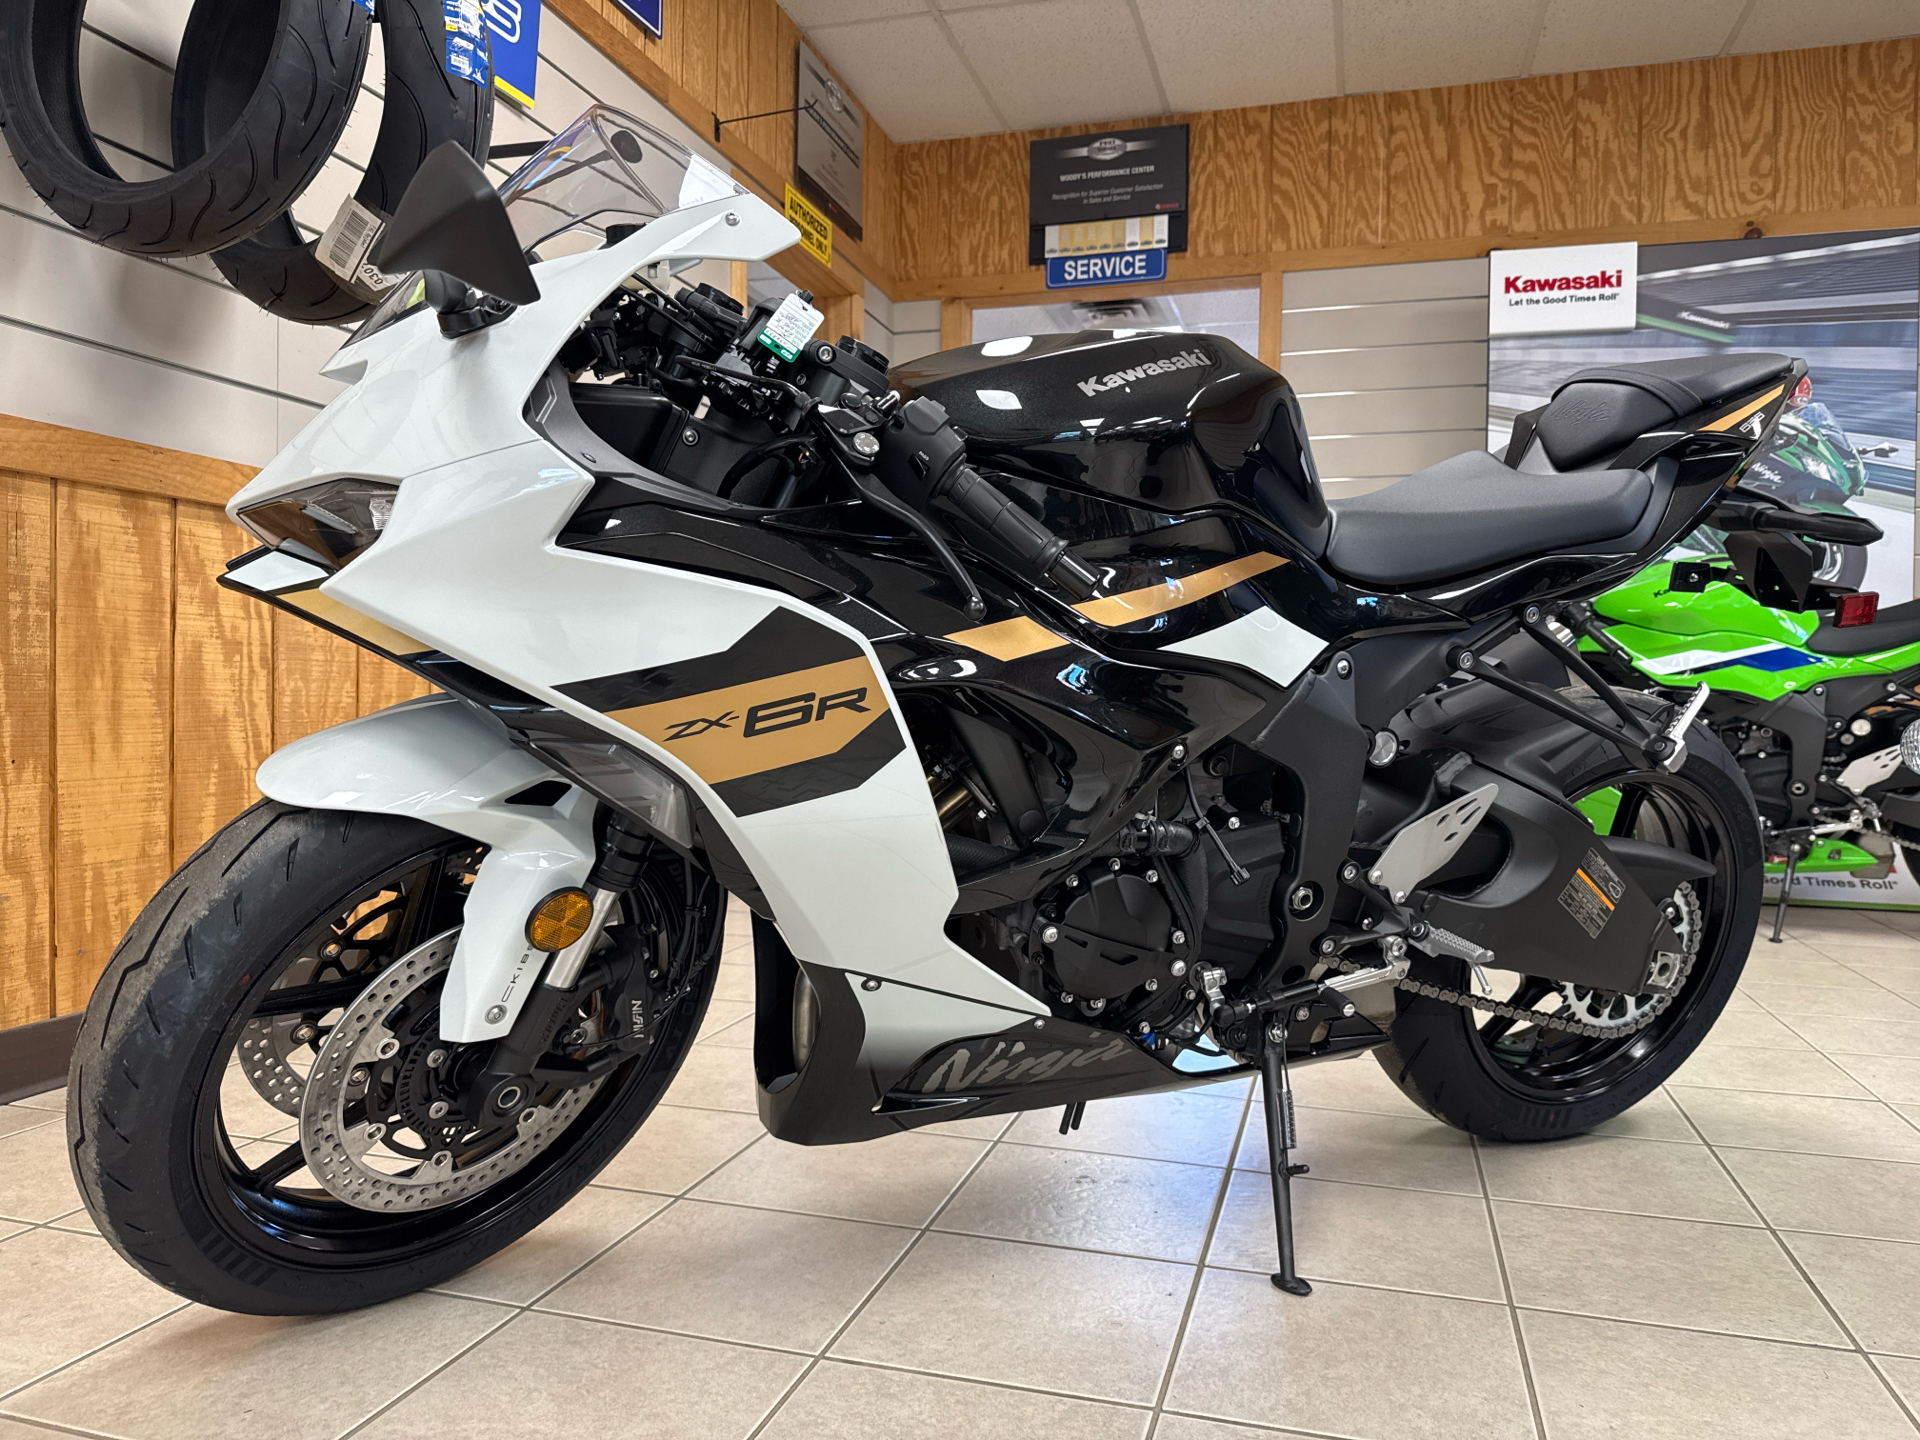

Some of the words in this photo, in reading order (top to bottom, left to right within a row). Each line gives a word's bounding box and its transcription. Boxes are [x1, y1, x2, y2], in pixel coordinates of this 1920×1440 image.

[1087, 168, 1130, 179] PERFORMANCE
[1131, 165, 1155, 174] CENTER
[1110, 186, 1133, 195] Customer
[1134, 183, 1163, 193] Satisfaction
[1113, 194, 1131, 202] Service
[790, 196, 828, 241] AUTHORIZED
[1064, 254, 1147, 280] SERVICE
[1504, 270, 1622, 293] Kawasaki
[1509, 298, 1523, 306] Let
[1525, 297, 1541, 305] the
[1542, 296, 1567, 305] Good
[1569, 294, 1597, 303] Times
[1680, 310, 1732, 330] Kawasaki
[1077, 348, 1212, 397] Kawasaki
[1752, 461, 1785, 485] Ninja
[661, 686, 872, 743] ZX-6R
[1803, 876, 1855, 889] Times
[921, 1030, 1133, 1094] Ninja
